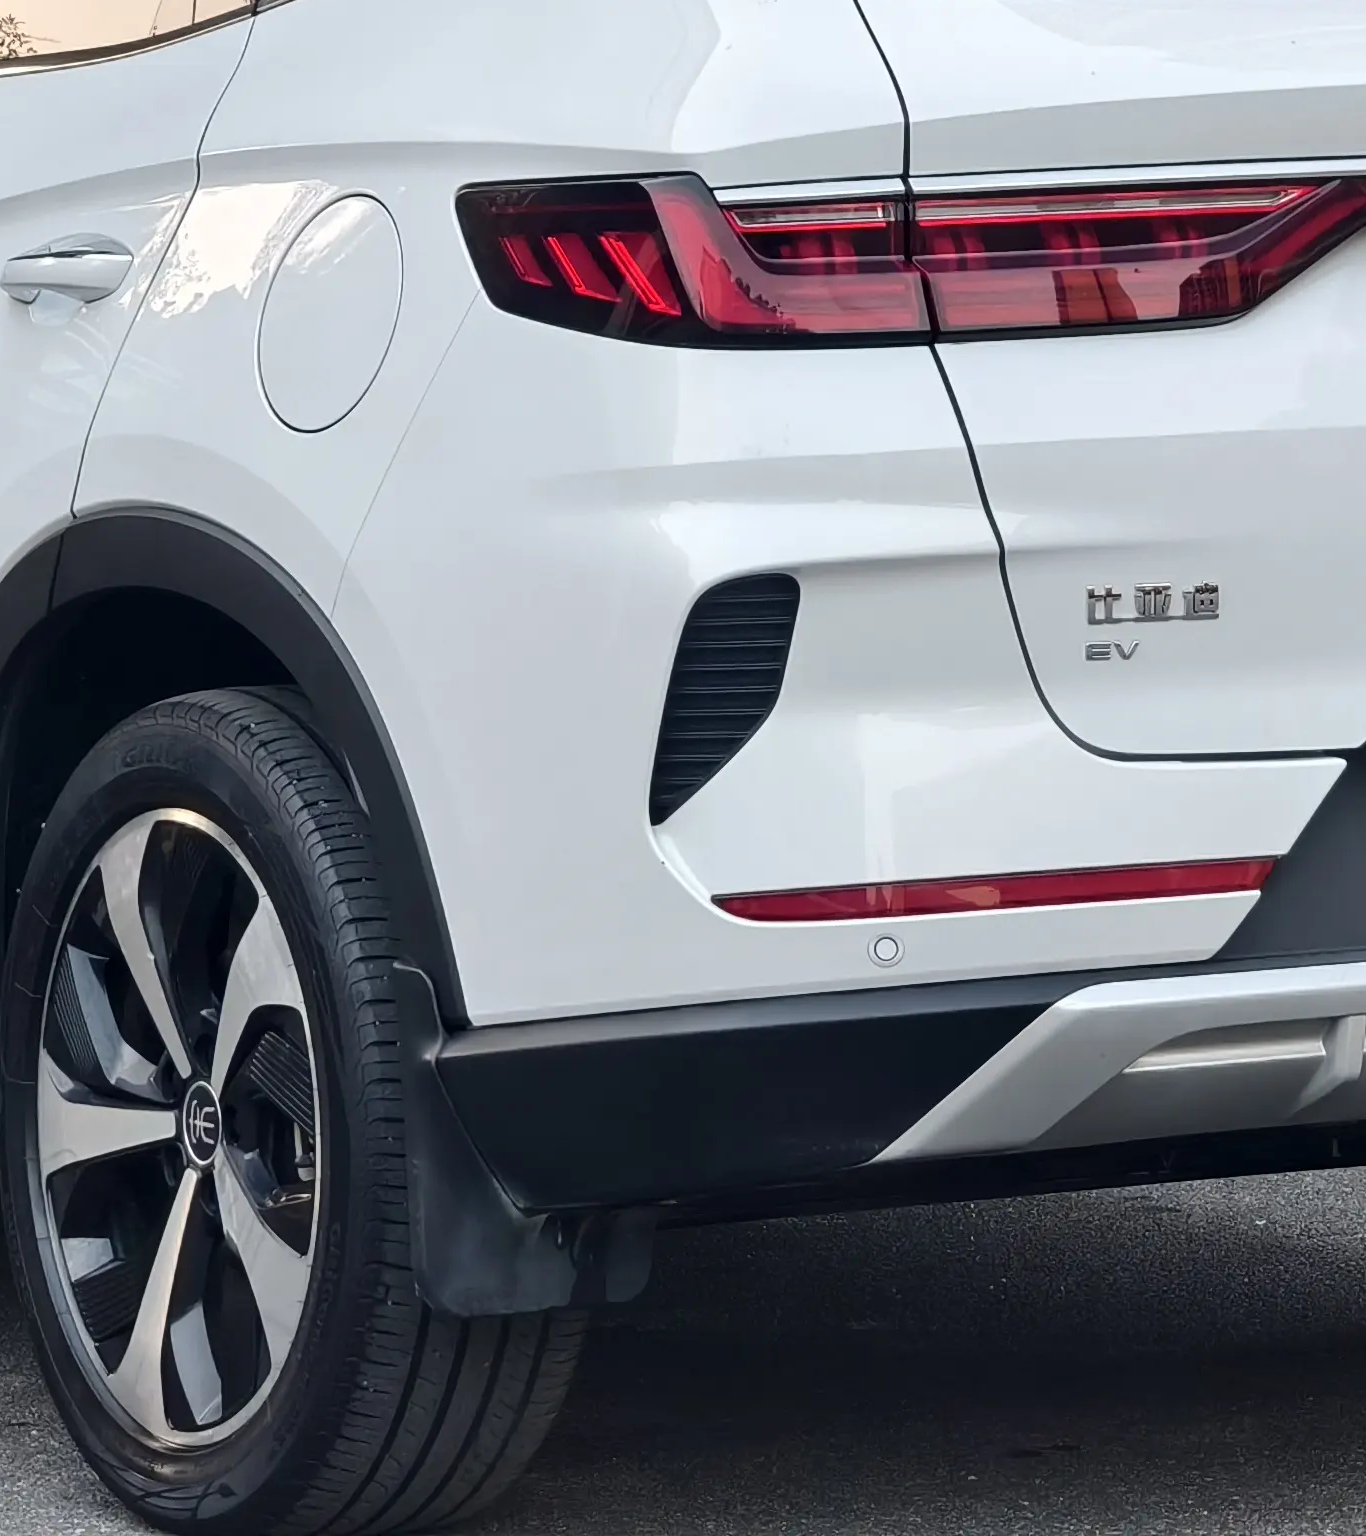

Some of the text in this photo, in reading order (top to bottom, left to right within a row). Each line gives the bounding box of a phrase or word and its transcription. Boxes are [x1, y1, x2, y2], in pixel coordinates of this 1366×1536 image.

[1085, 580, 1220, 625] 比亚迪
[1084, 639, 1141, 662] EV
